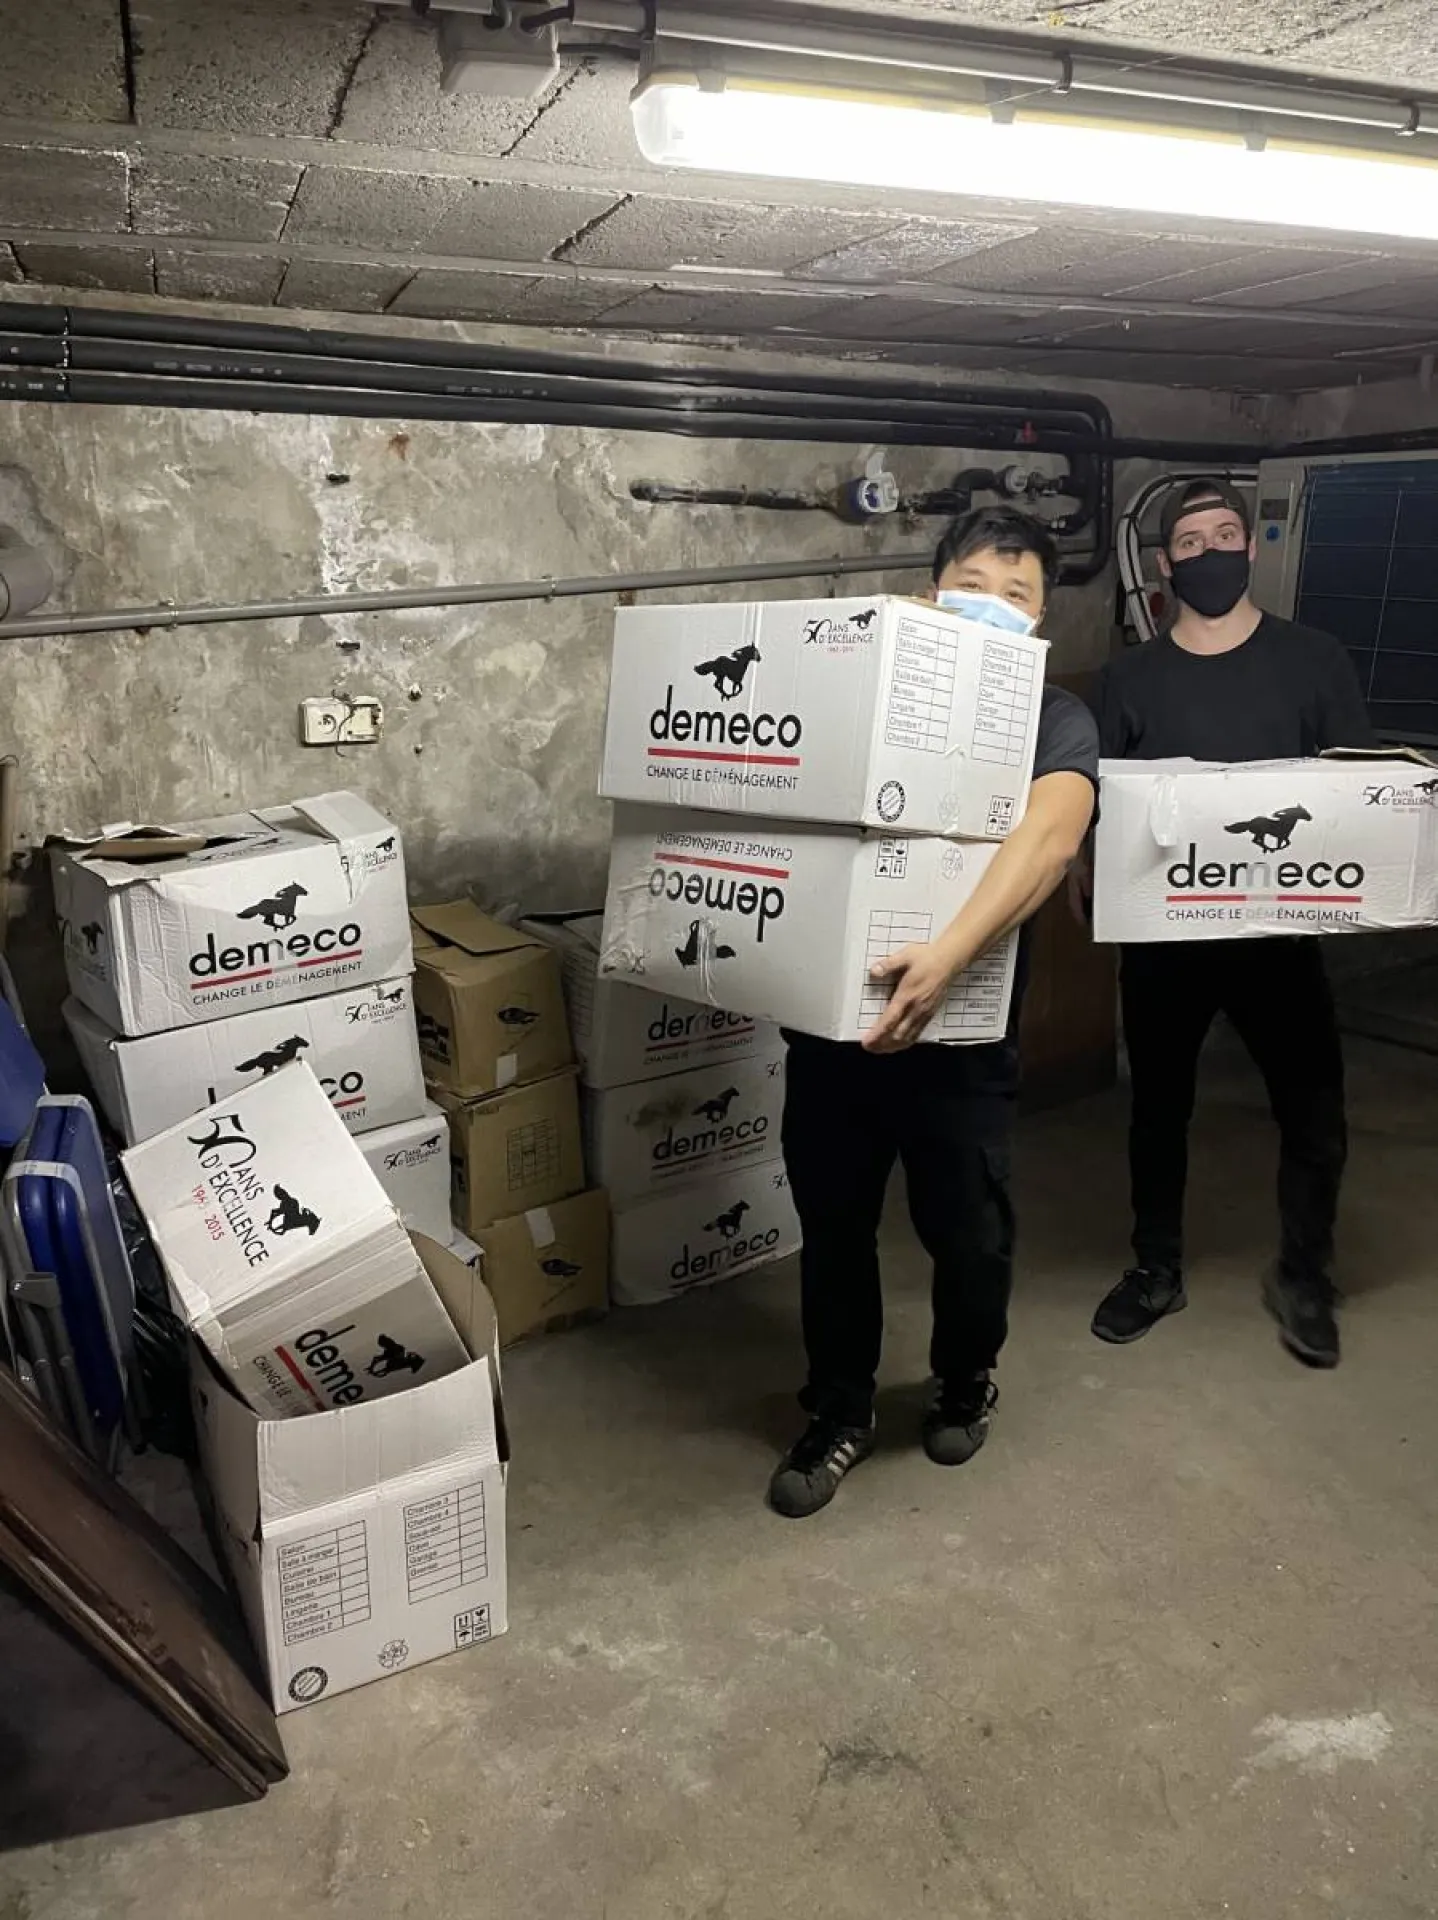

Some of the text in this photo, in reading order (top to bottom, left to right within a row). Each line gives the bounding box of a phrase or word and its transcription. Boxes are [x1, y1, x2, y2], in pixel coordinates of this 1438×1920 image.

[803, 618, 832, 643] 50
[651, 685, 802, 748] demeco
[646, 765, 688, 780] CHANGE
[692, 769, 703, 782] LE
[1362, 785, 1396, 806] 50
[734, 841, 745, 854] LE
[745, 844, 793, 861] CHANGE
[1167, 843, 1365, 888] demeco
[650, 868, 785, 943] demeco
[1166, 909, 1224, 921] CHANGE
[1229, 908, 1241, 920] LE
[189, 923, 361, 976] demeco
[193, 986, 247, 1005] CHANGE
[251, 980, 263, 993] LE
[345, 1003, 370, 1024] 50
[653, 1116, 768, 1161] demeco
[187, 1114, 265, 1201] 50 ANS
[200, 1153, 270, 1268] D'EXCELLENCE
[205, 1213, 225, 1241] 2015
[671, 1228, 780, 1279] demeco
[294, 1324, 364, 1405] deme
